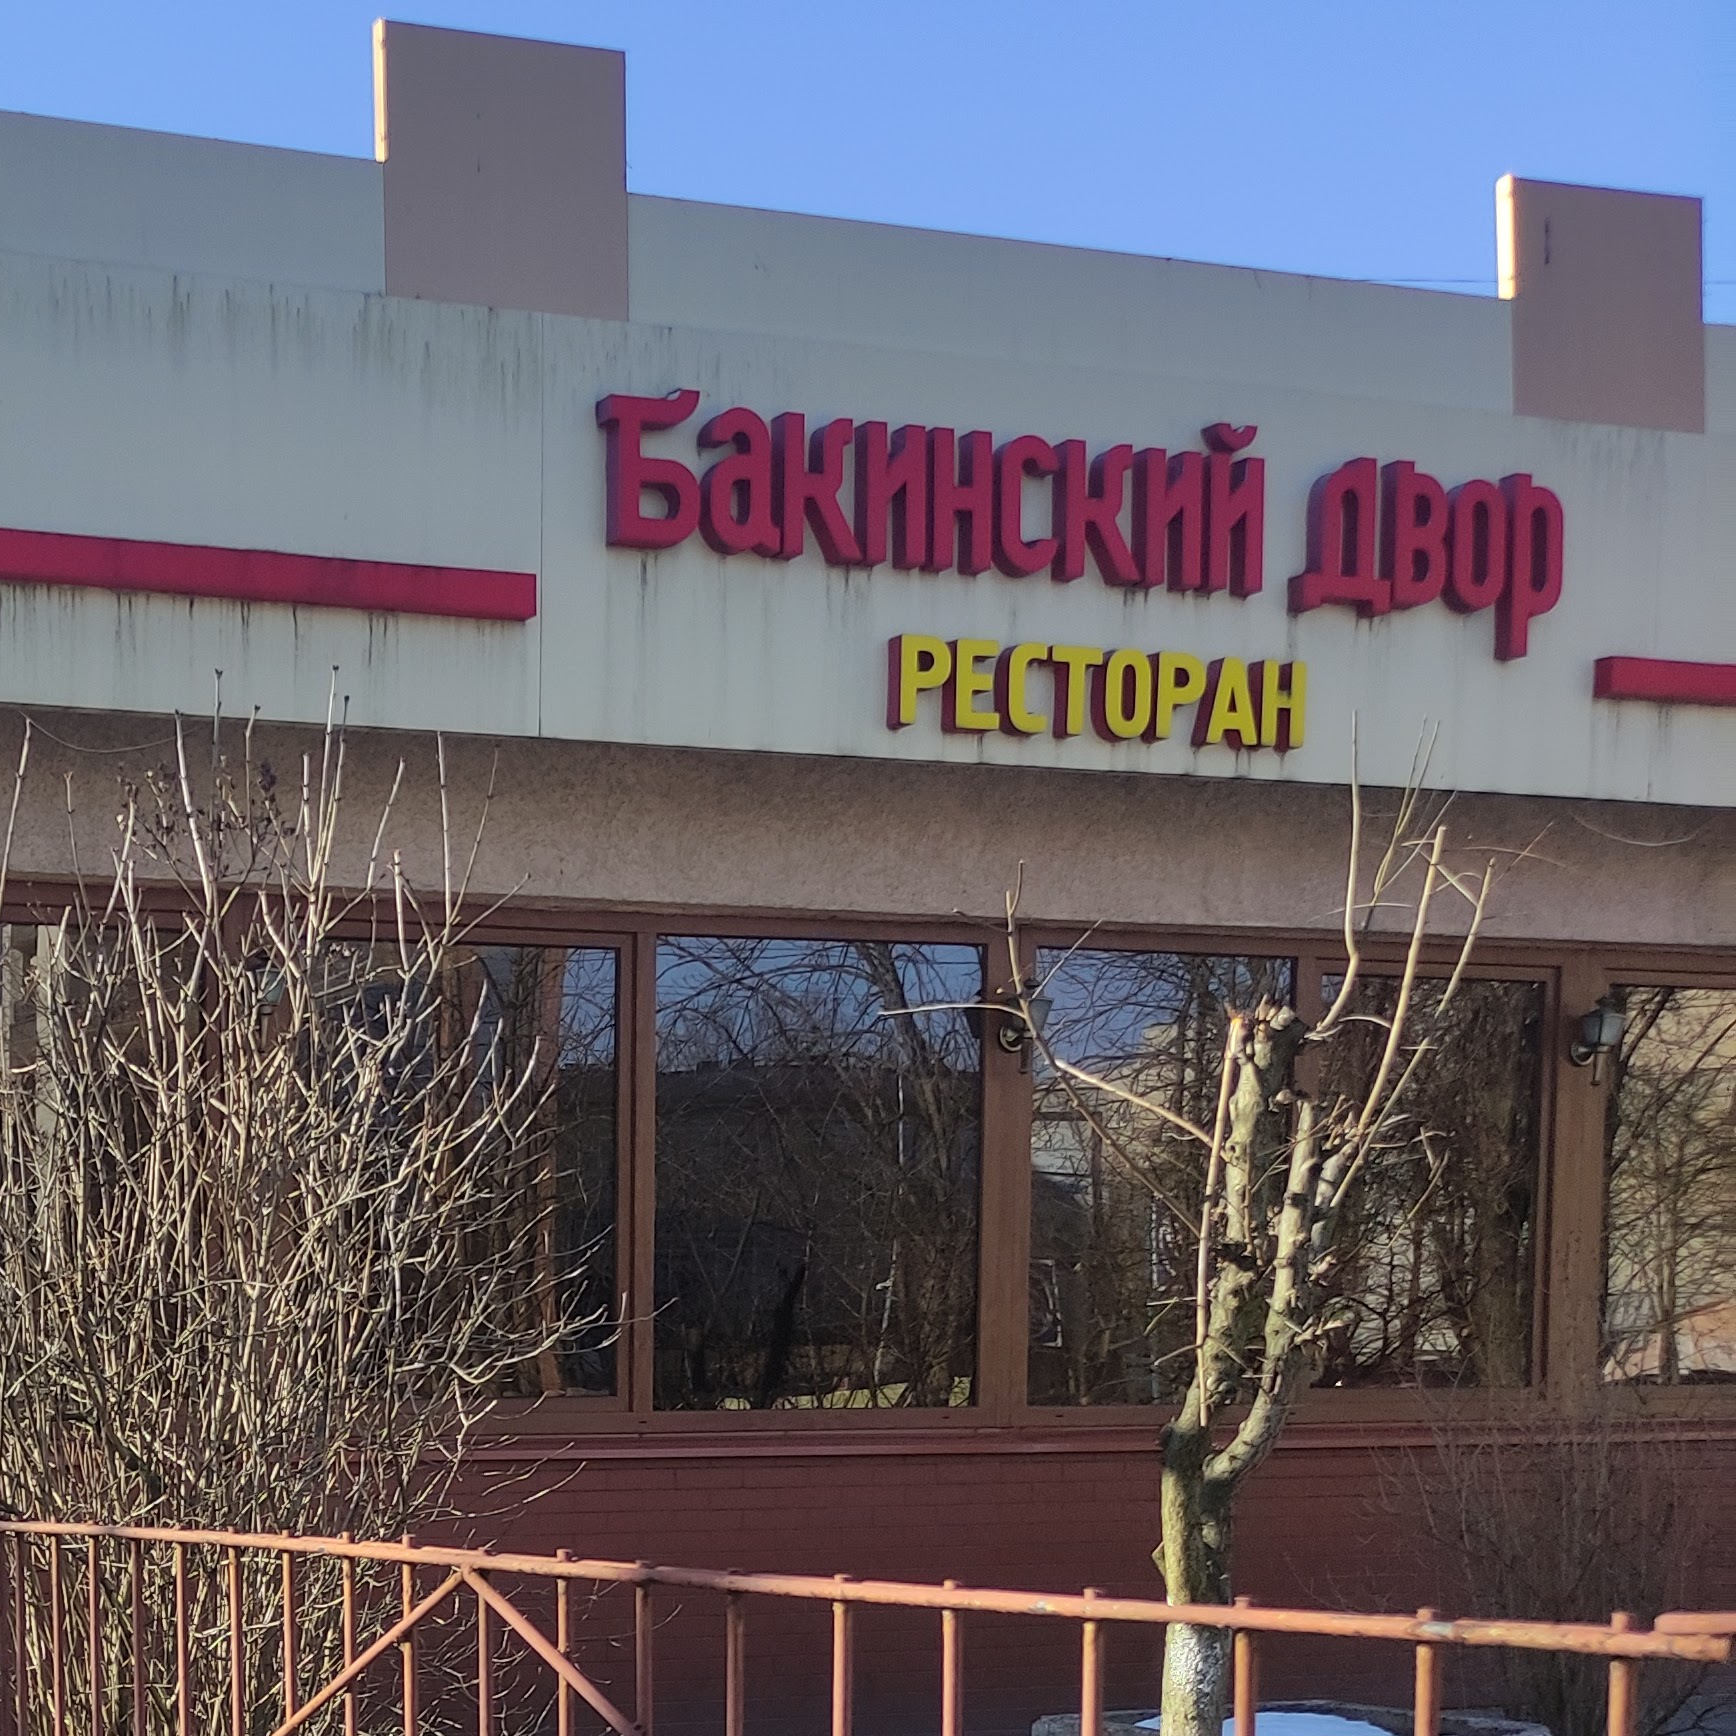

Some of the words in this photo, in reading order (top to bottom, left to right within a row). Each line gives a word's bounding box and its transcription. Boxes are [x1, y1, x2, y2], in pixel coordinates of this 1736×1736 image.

[596, 388, 1265, 599] Бакинский
[1287, 457, 1563, 661] двор
[886, 633, 1307, 753] РЕСТОРАН
